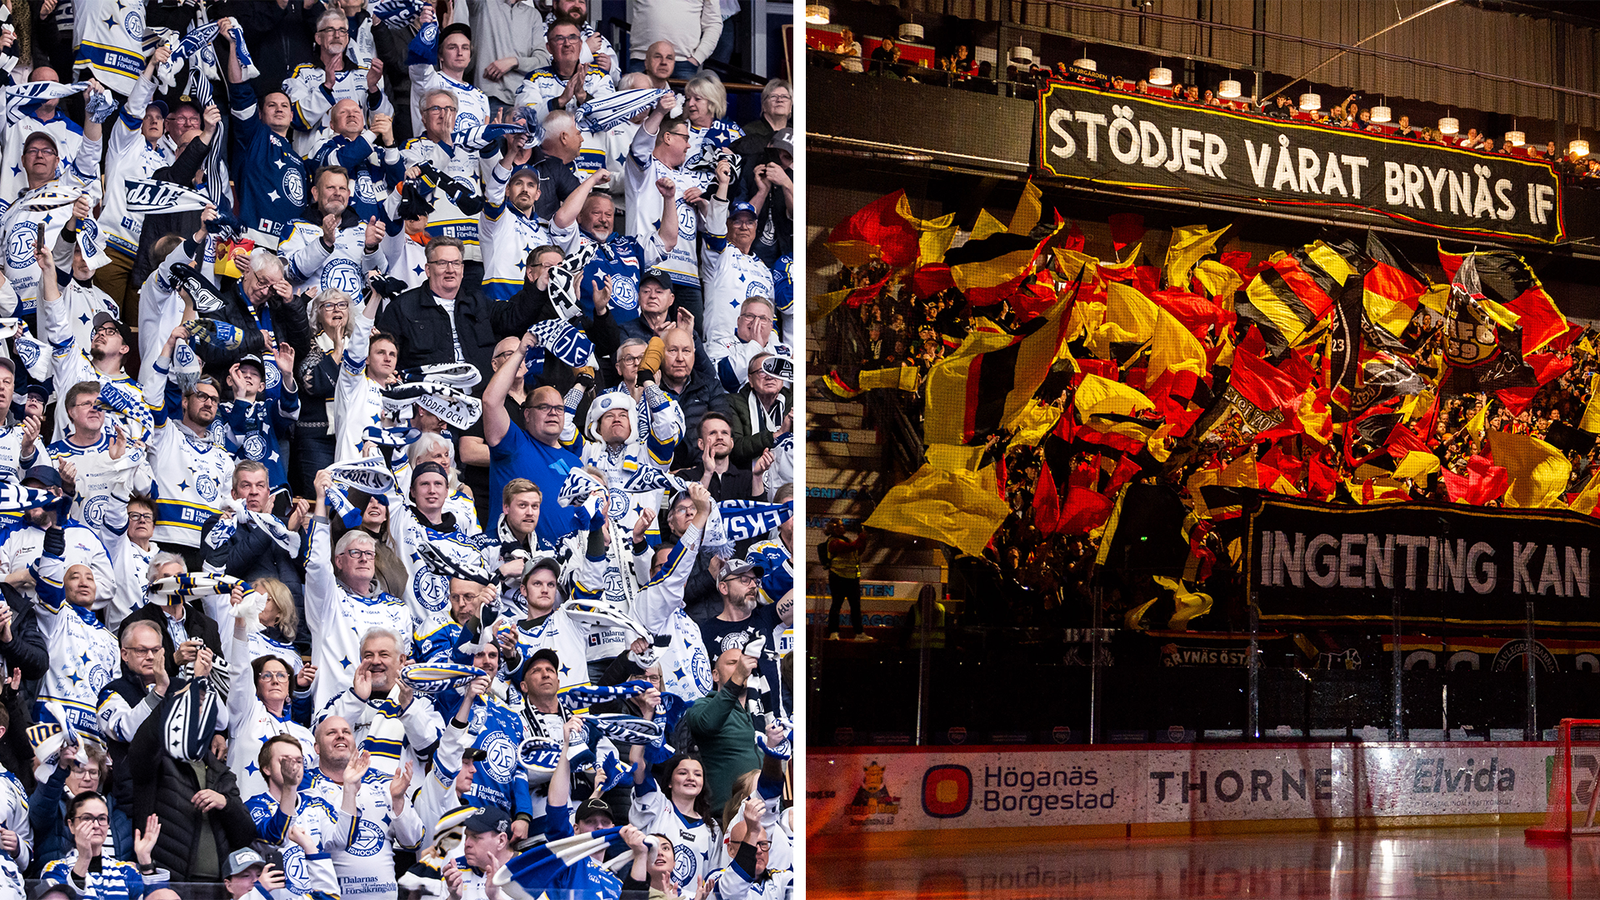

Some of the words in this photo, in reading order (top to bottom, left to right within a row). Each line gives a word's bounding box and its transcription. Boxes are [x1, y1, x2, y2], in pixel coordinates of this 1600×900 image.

[1049, 104, 1228, 180] STÖDJER
[1244, 134, 1369, 200] VÅRAT
[1384, 163, 1516, 221] BRYNÄS
[1527, 183, 1555, 225] IF
[446, 411, 464, 425] OCH
[1260, 530, 1498, 595] INGENTING
[1512, 540, 1591, 599] KAN
[1496, 642, 1555, 671] GÄVLEGRBARNA
[983, 766, 1098, 789] Höganäs
[1150, 768, 1334, 804] THORNE
[1412, 756, 1516, 794] Elvida
[983, 788, 1115, 816] Borgestad
[347, 844, 381, 857] ISHOCKEY
[343, 876, 379, 884] Dalarnas
